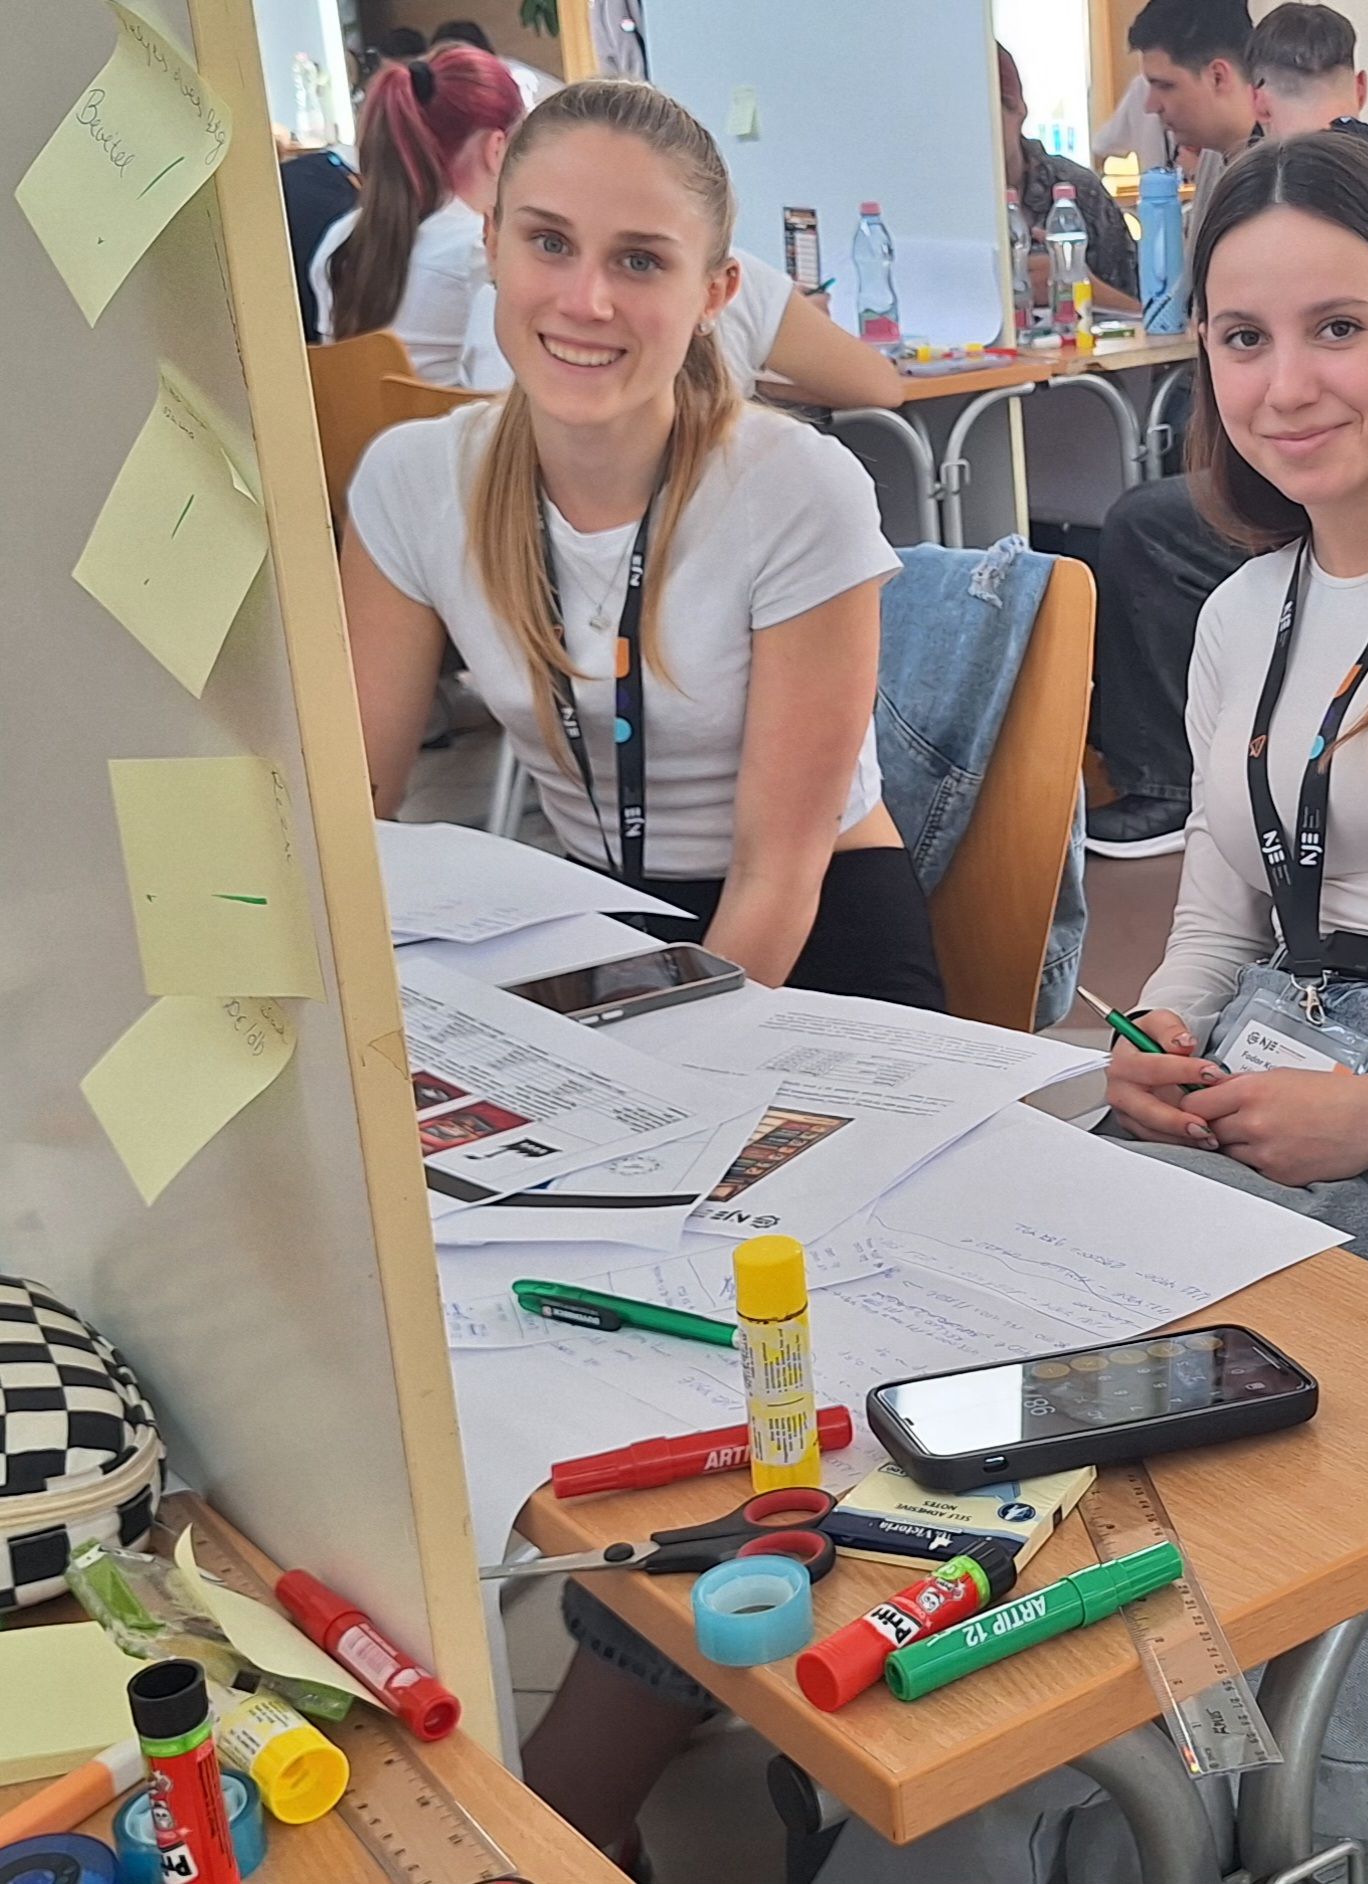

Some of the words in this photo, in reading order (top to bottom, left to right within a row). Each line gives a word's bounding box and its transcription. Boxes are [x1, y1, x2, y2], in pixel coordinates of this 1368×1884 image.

[623, 805, 647, 838] NJE
[1261, 829, 1286, 866] NJE
[1299, 831, 1324, 867] NJE
[895, 1502, 946, 1518] ADHESIVE
[923, 1499, 958, 1511] NOTES
[948, 1512, 972, 1522] SELF
[879, 1520, 933, 1540] Victoria
[869, 1607, 912, 1645] Pritt
[992, 1594, 1047, 1636] ARTIP
[961, 1621, 989, 1648] 12
